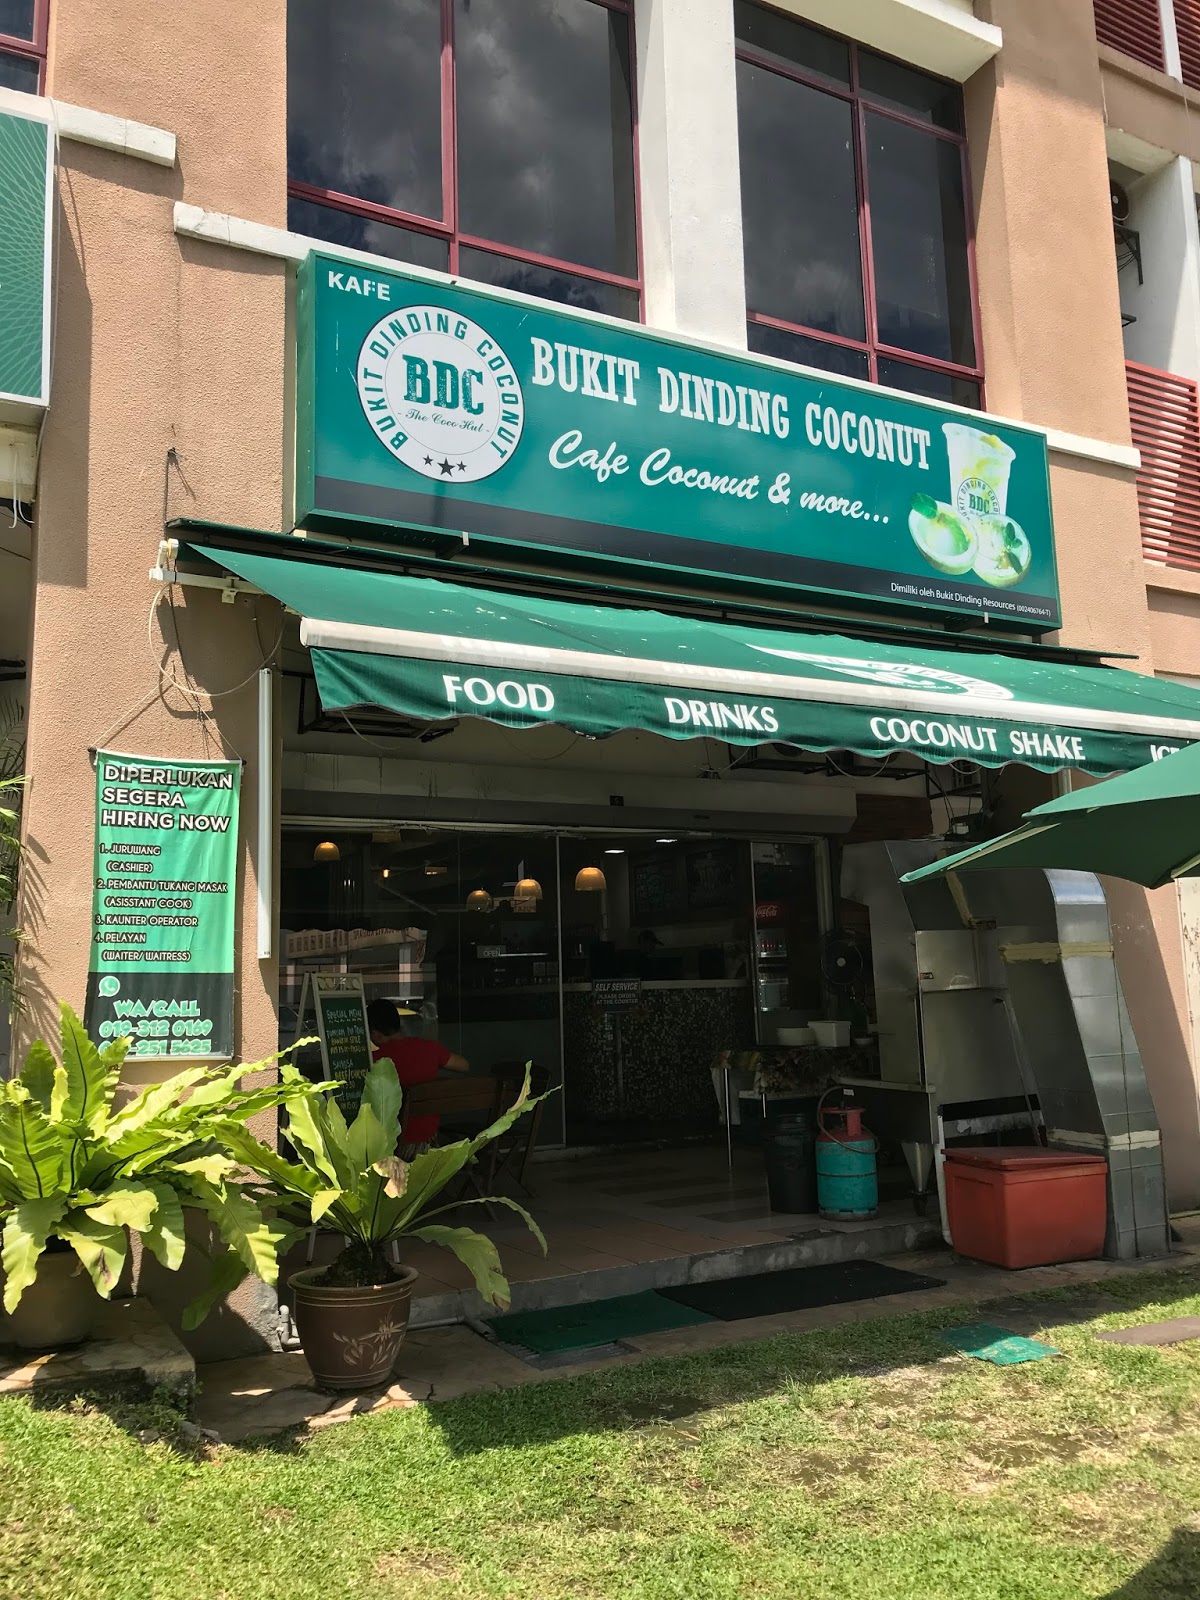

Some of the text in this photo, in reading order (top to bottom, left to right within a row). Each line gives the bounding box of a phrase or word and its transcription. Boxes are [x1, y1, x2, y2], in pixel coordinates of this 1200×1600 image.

[328, 270, 391, 301] KAFE
[363, 312, 520, 459] BUKIT DINDING COCONUT
[402, 354, 484, 416] BDC
[530, 336, 931, 471] BUKIT DINDING COCONUT
[405, 408, 484, 432] The Coco Hut
[548, 430, 889, 524] Cafe Coconut & more...
[969, 493, 990, 514] BDC
[890, 582, 918, 596] Dimiliki
[919, 588, 935, 598] oleh
[936, 589, 954, 601] Bukit
[955, 593, 982, 607] Dinding
[982, 597, 1016, 611] Resources
[442, 674, 1180, 763] FOOD DRINKS COCONUT SHAKE IC
[104, 764, 234, 790] DIPERLUKAN
[102, 787, 187, 809] SEGERA
[101, 809, 232, 833] HIRING NOW
[110, 844, 161, 856] JURUWANG
[106, 861, 153, 873] (CASHIER)
[96, 879, 228, 893] 2. PEMBANTU TUKANG MASAK
[104, 896, 193, 909] (ASISSTANT COOK)
[95, 915, 199, 927] 3. KAUNTER OPERATOR
[94, 932, 147, 943] 4. PELAYAN
[594, 982, 638, 991] SELF SERVICE
[113, 999, 200, 1019] WA/CALL
[99, 1019, 213, 1038] 019-312 0169
[170, 1039, 212, 1056] 5625
